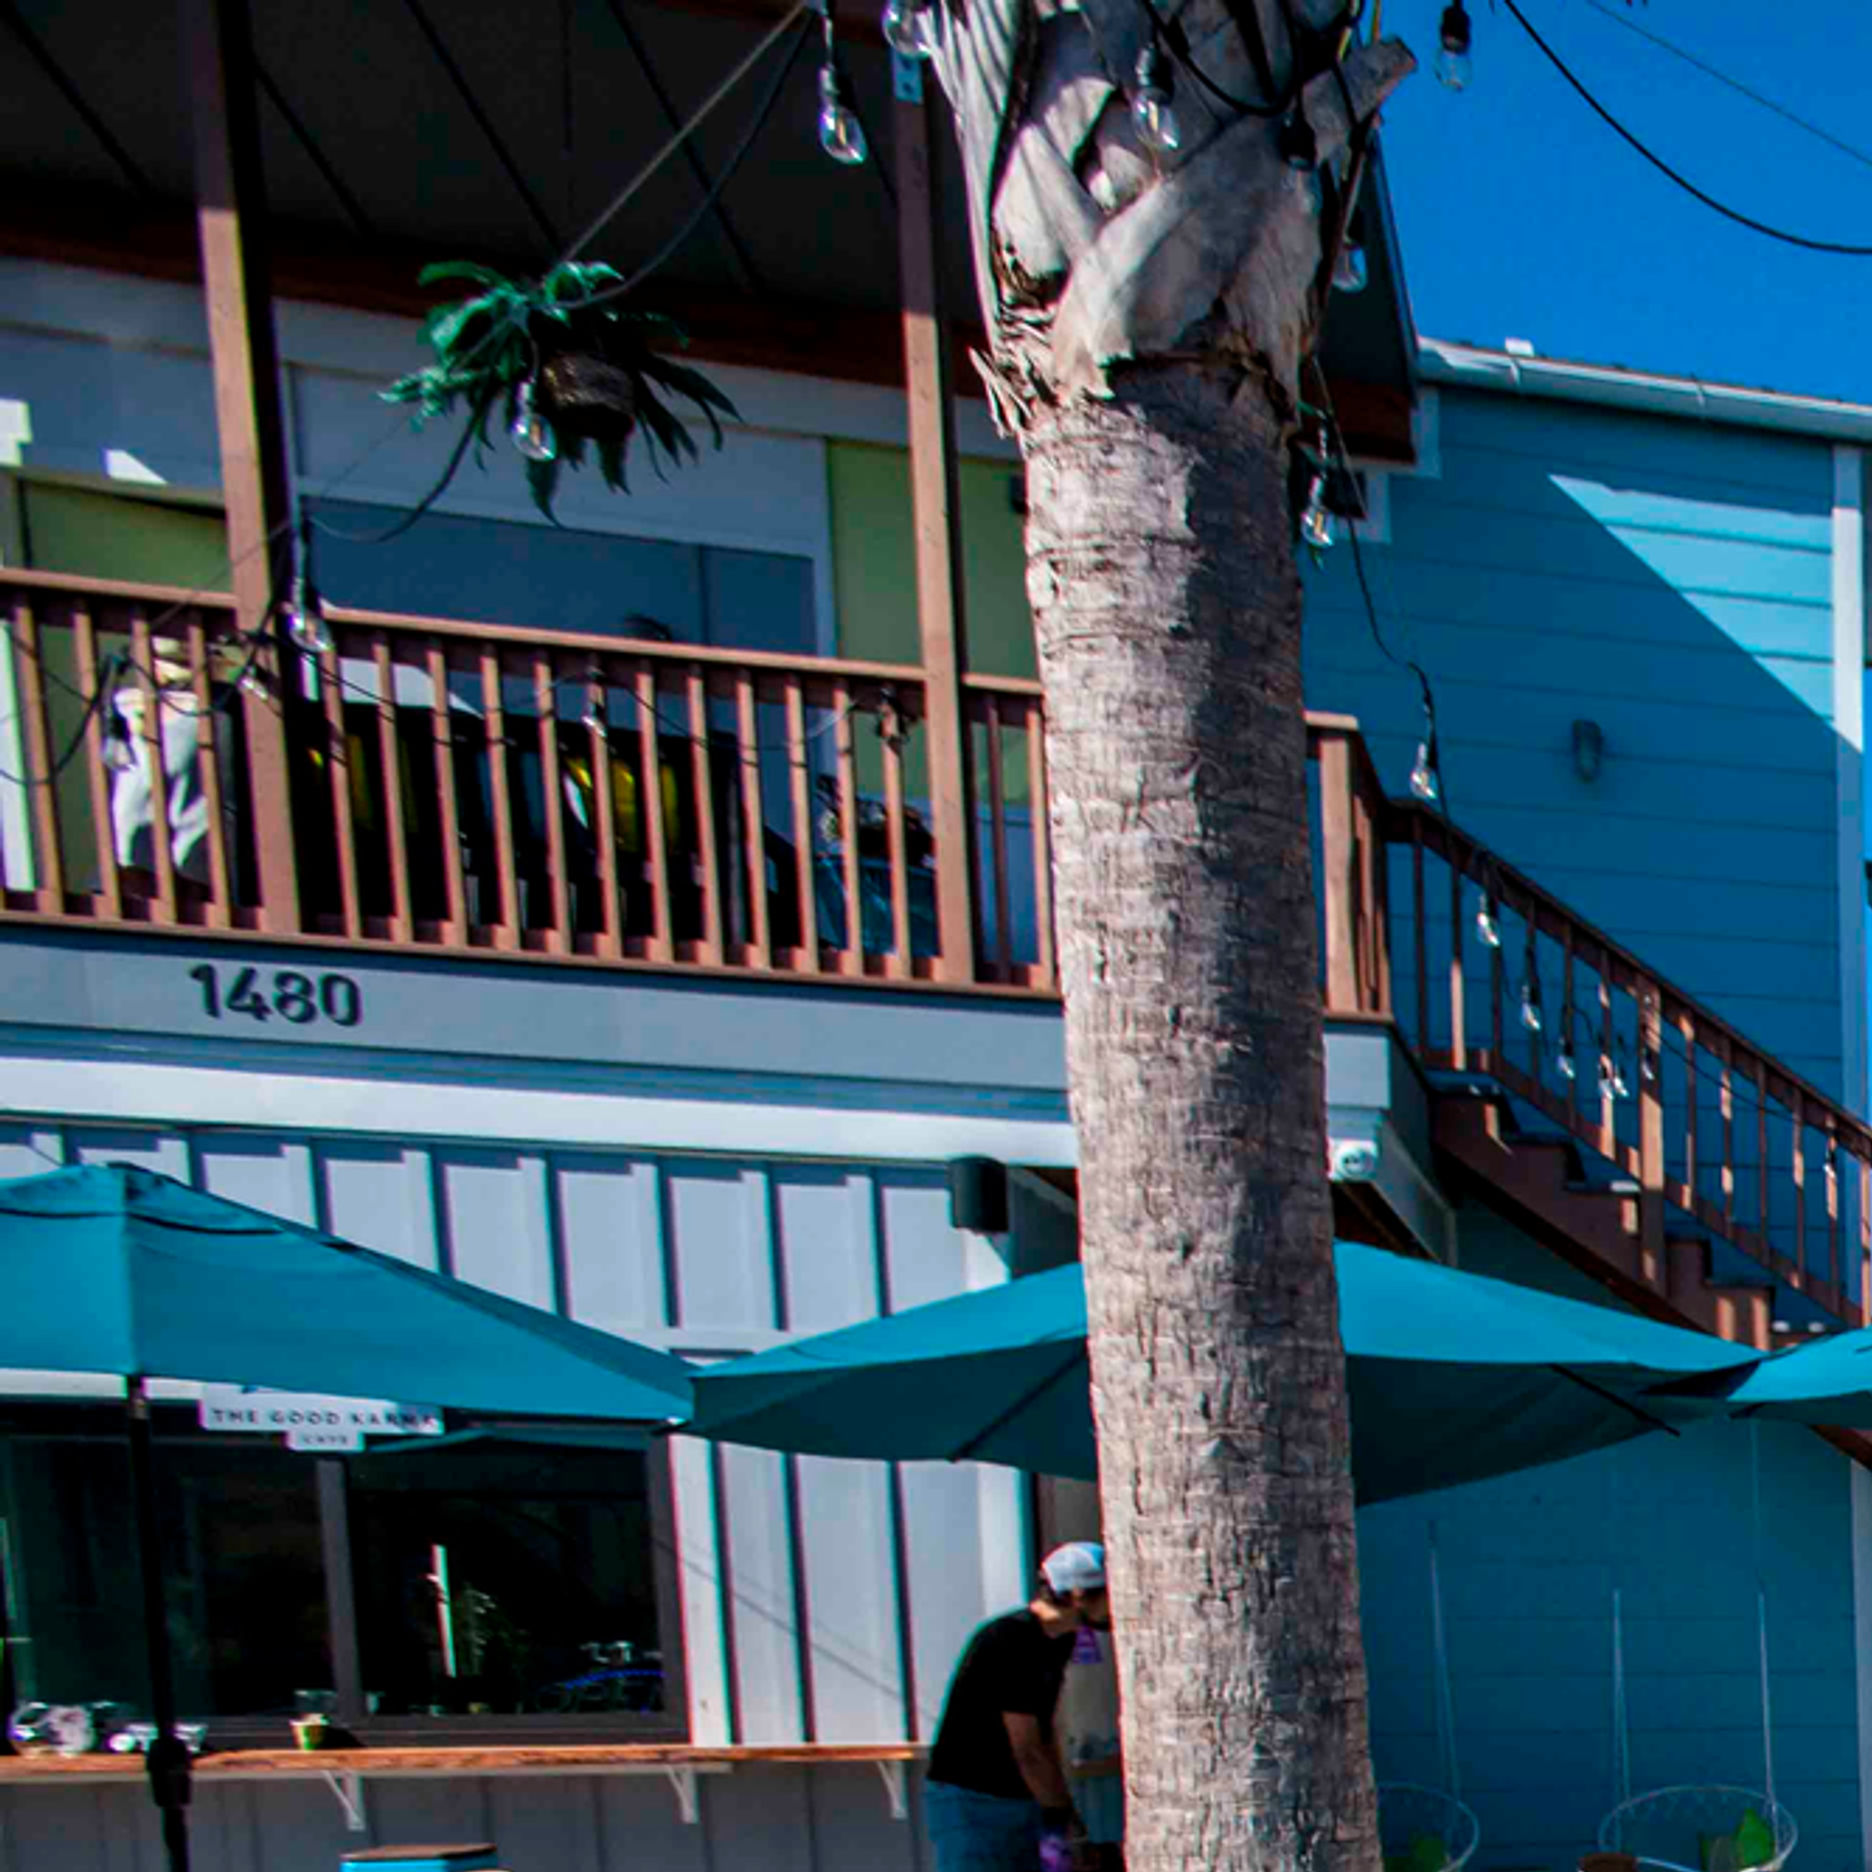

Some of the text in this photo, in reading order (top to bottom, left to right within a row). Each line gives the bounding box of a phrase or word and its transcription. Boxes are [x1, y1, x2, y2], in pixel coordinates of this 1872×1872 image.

[189, 963, 361, 1027] 1480
[211, 1408, 259, 1424] THE
[269, 1410, 341, 1426] GOOD
